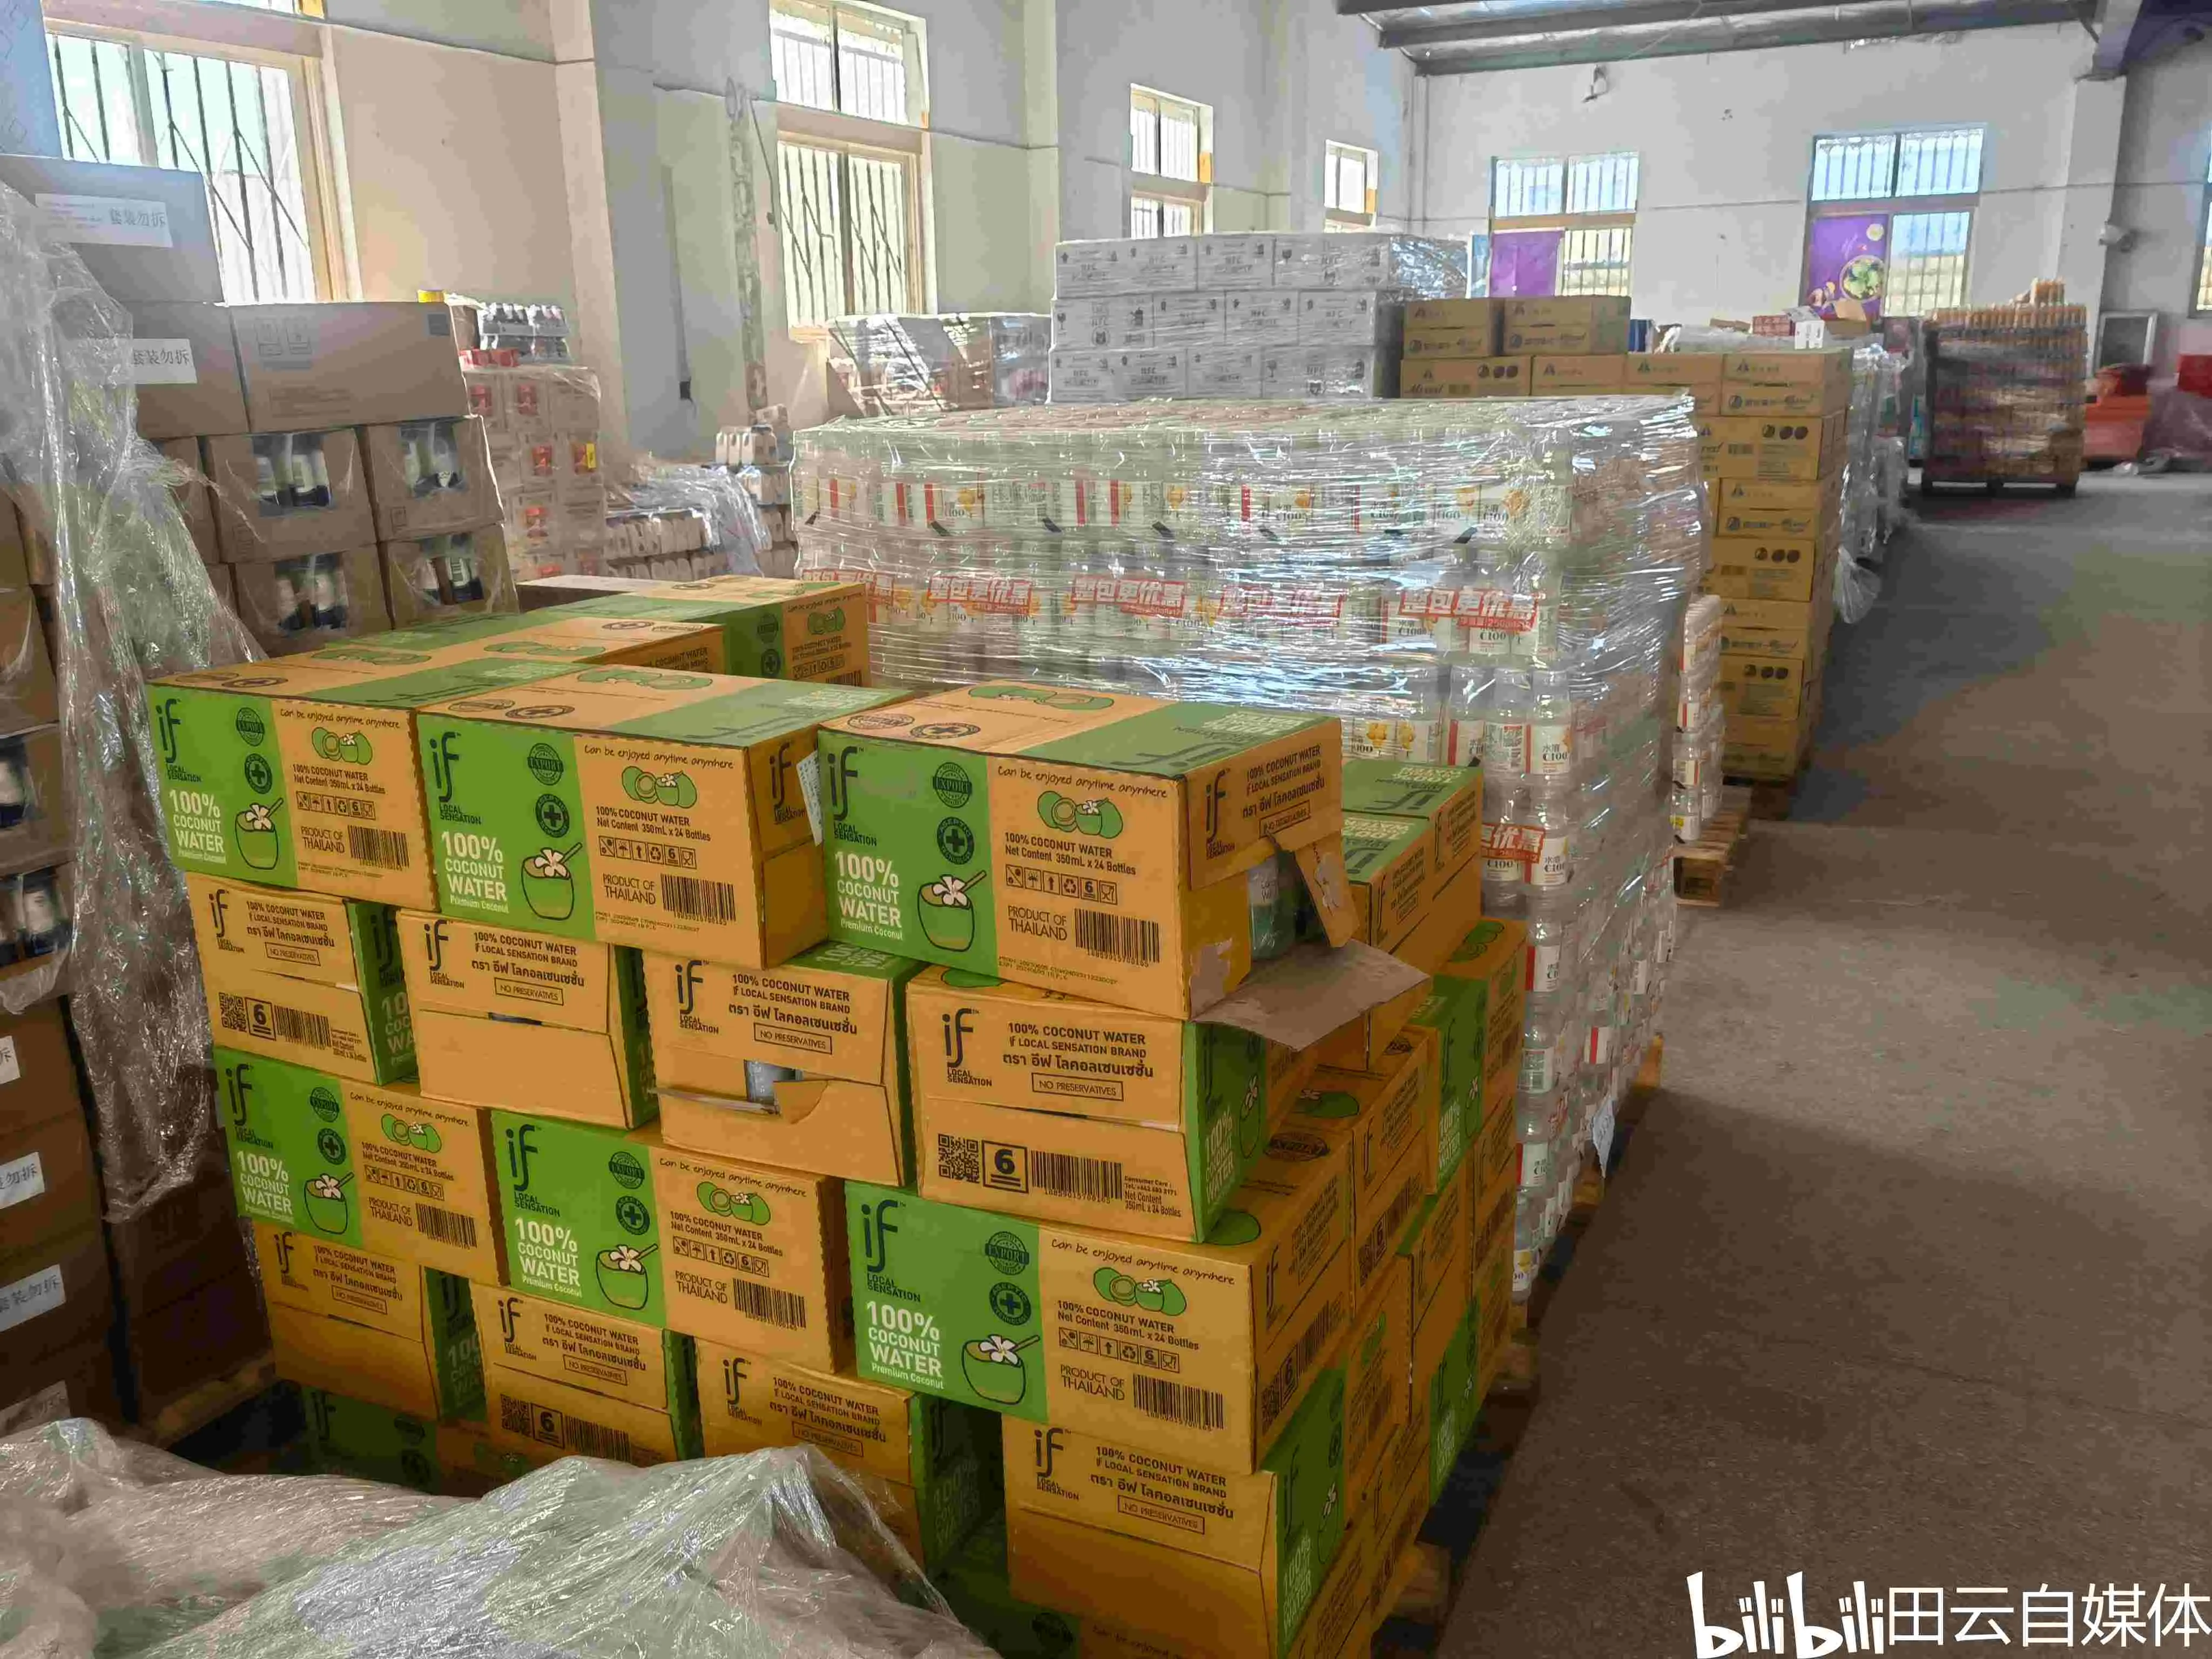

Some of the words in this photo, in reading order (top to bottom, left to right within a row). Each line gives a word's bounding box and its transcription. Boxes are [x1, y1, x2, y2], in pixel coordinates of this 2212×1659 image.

[618, 748, 651, 764] enjoyed
[653, 753, 688, 767] anytime
[691, 758, 734, 770] anywhere
[1265, 753, 1297, 774] COCONUT
[1299, 744, 1321, 759] WATER
[1021, 768, 1032, 779] be
[1036, 772, 1071, 786] enjoyed
[1076, 777, 1116, 791] anytime
[1118, 783, 1167, 798] anywhere
[168, 789, 220, 818] 100%
[173, 814, 221, 834] COCONUT
[440, 811, 481, 825] SENSATION
[596, 806, 617, 818] 100%
[618, 808, 658, 822] COCONUT
[660, 813, 690, 827] WATER
[611, 820, 638, 834] Content
[175, 828, 224, 853] WATER
[441, 831, 503, 864] 100%
[834, 831, 877, 846] SENSATION
[1005, 832, 1029, 845] 100%
[1031, 836, 1076, 853] COCONUT
[1078, 844, 1112, 859] WATER
[445, 859, 504, 880] COCONUT
[835, 852, 899, 888] 100%
[1006, 845, 1020, 857] Net
[1021, 848, 1052, 862] Content
[1056, 852, 1085, 867] 350mL
[1094, 858, 1105, 870] 24
[1107, 860, 1136, 875] Bottles
[448, 874, 507, 902] WATER
[603, 873, 640, 889] PRODUCT
[838, 880, 899, 900] COCONUT
[1084, 881, 1093, 894] 6
[604, 885, 657, 905] THAILAND
[266, 903, 299, 917] COCONUT
[300, 908, 325, 921] WATER
[839, 897, 902, 928] WATER
[1008, 906, 1050, 923] PRODUCT
[1053, 914, 1067, 925] OF
[841, 920, 873, 934] Premium
[874, 927, 903, 941] Coconut
[1009, 918, 1068, 941] THAILAND
[474, 932, 497, 943] 100%
[500, 935, 543, 949] COCONUT
[545, 943, 576, 956] WATER
[482, 945, 505, 956] LOCAL
[507, 948, 549, 963] SENSATION
[551, 956, 578, 967] BRAND
[513, 986, 558, 1001] PRESERVATIVES
[732, 974, 759, 987] 100%
[761, 977, 811, 995] COCONUT
[814, 986, 850, 1001] WATER
[740, 988, 768, 1000] LOCAL
[770, 992, 817, 1008] SENSATION
[819, 1001, 851, 1014] BRAND
[253, 1004, 267, 1026] 6
[680, 1022, 719, 1034] SENSATION
[760, 1030, 772, 1039] NO
[774, 1032, 826, 1049] PRESERVATIVES
[1008, 1022, 1039, 1036] 100%
[1042, 1024, 1101, 1042] COCONUT
[1104, 1031, 1145, 1045] WATER
[1018, 1038, 1049, 1050] LOCAL
[1052, 1041, 1108, 1054] SENSATION
[1110, 1045, 1147, 1058] BRAND
[947, 1075, 993, 1087] SENSATION
[1039, 1080, 1053, 1089] NO
[1056, 1081, 1117, 1096] PRESERVATIVES
[237, 1150, 288, 1182] 100%
[994, 1149, 1015, 1175] 6
[240, 1174, 289, 1196] COCONUT
[241, 1188, 293, 1215] WATER
[1161, 1205, 1181, 1217] Bottles
[515, 1217, 578, 1253] 100%
[693, 1215, 731, 1233] COCONUT
[732, 1226, 763, 1241] WATER
[517, 1243, 578, 1267] COCONUT
[1076, 1243, 1089, 1254] be
[1092, 1248, 1132, 1267] enjoyed
[1137, 1256, 1178, 1275] anytime
[1183, 1265, 1236, 1285] anywhere
[518, 1256, 580, 1287] WATER
[675, 1271, 712, 1287] PRODUCT
[676, 1281, 727, 1304] THAILAND
[867, 1282, 921, 1303] SENSATION
[866, 1301, 940, 1341] 100%
[1057, 1300, 1083, 1314] 100%
[1086, 1305, 1135, 1325] COCONUT
[1137, 1316, 1175, 1333] WATER
[568, 1319, 607, 1336] COCONUT
[609, 1330, 639, 1345] WATER
[868, 1327, 941, 1358] COCONUT
[1057, 1311, 1073, 1323] Net
[1075, 1315, 1110, 1331] Content
[1113, 1323, 1145, 1339] 350mL
[1154, 1331, 1166, 1343] 24
[1168, 1334, 1200, 1351] Bottles
[869, 1342, 943, 1377] WATER
[1144, 1350, 1154, 1360] 6
[872, 1362, 909, 1381] Premium
[910, 1371, 945, 1390] Coconut
[1060, 1364, 1107, 1383] PRODUCT
[1109, 1374, 1125, 1387] OF
[799, 1382, 843, 1405] COCONUT
[846, 1395, 879, 1416] WATER
[1061, 1375, 1125, 1402] THAILAND
[540, 1411, 554, 1432] 6
[1096, 1446, 1125, 1462] 100%
[1129, 1453, 1184, 1474] COCONUT
[1187, 1467, 1227, 1487] WATER
[1193, 1480, 1227, 1498] BRAND
